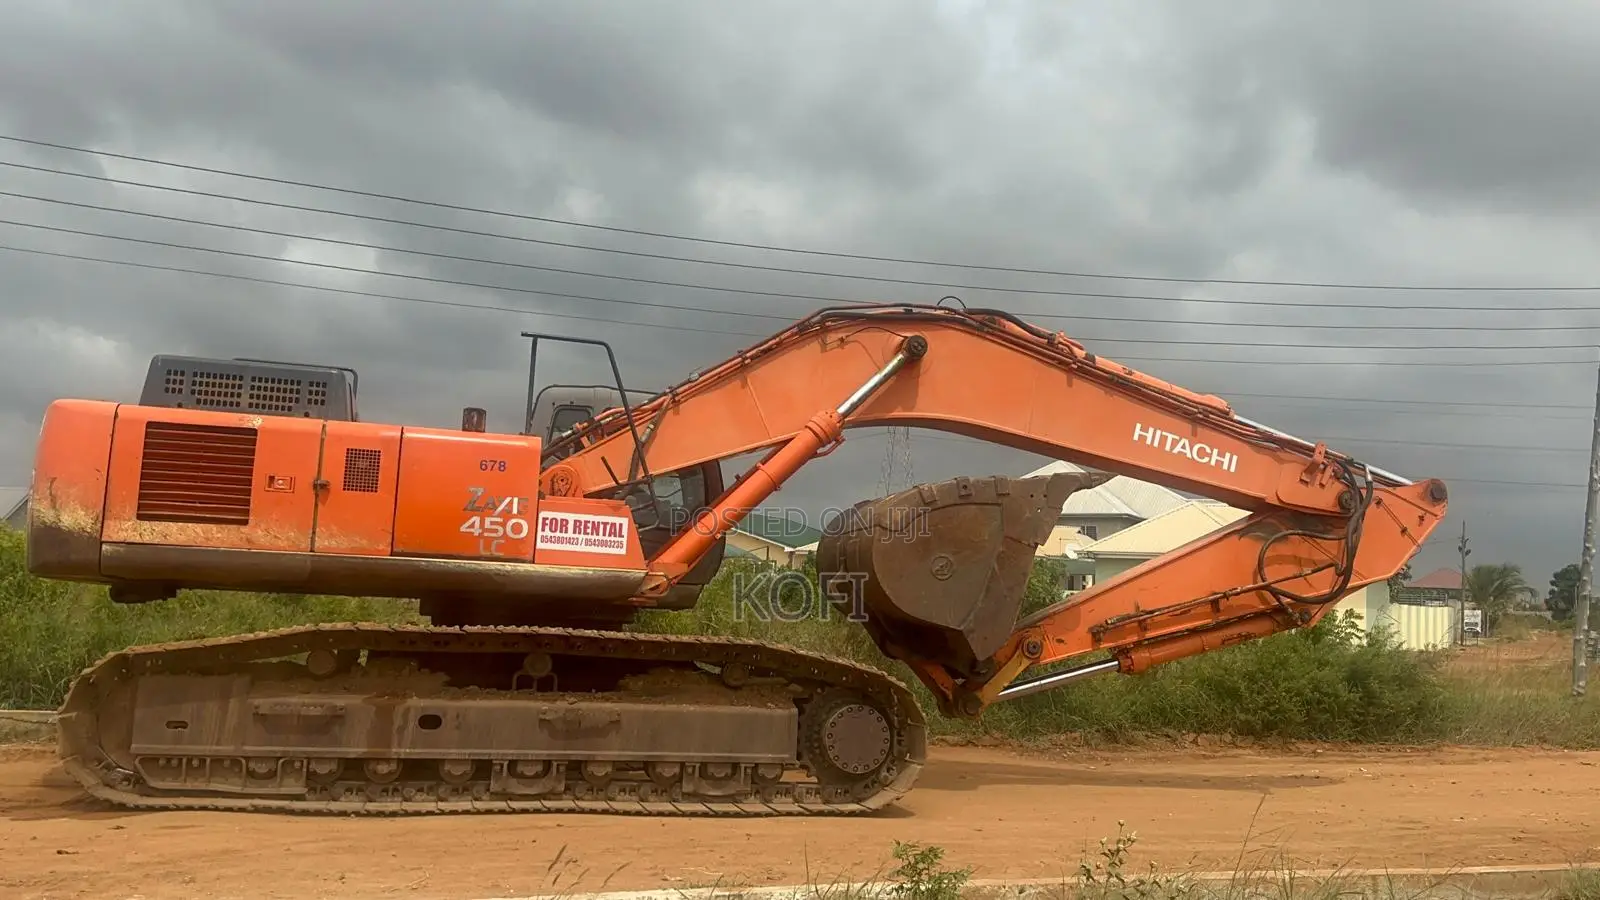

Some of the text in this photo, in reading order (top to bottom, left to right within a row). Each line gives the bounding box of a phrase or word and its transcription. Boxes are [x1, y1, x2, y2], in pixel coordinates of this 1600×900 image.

[1132, 422, 1239, 473] HITACHI
[479, 459, 507, 472] 678
[459, 515, 529, 539] 450
[541, 516, 625, 538] FOR RENTAL
[479, 538, 505, 555] LC
